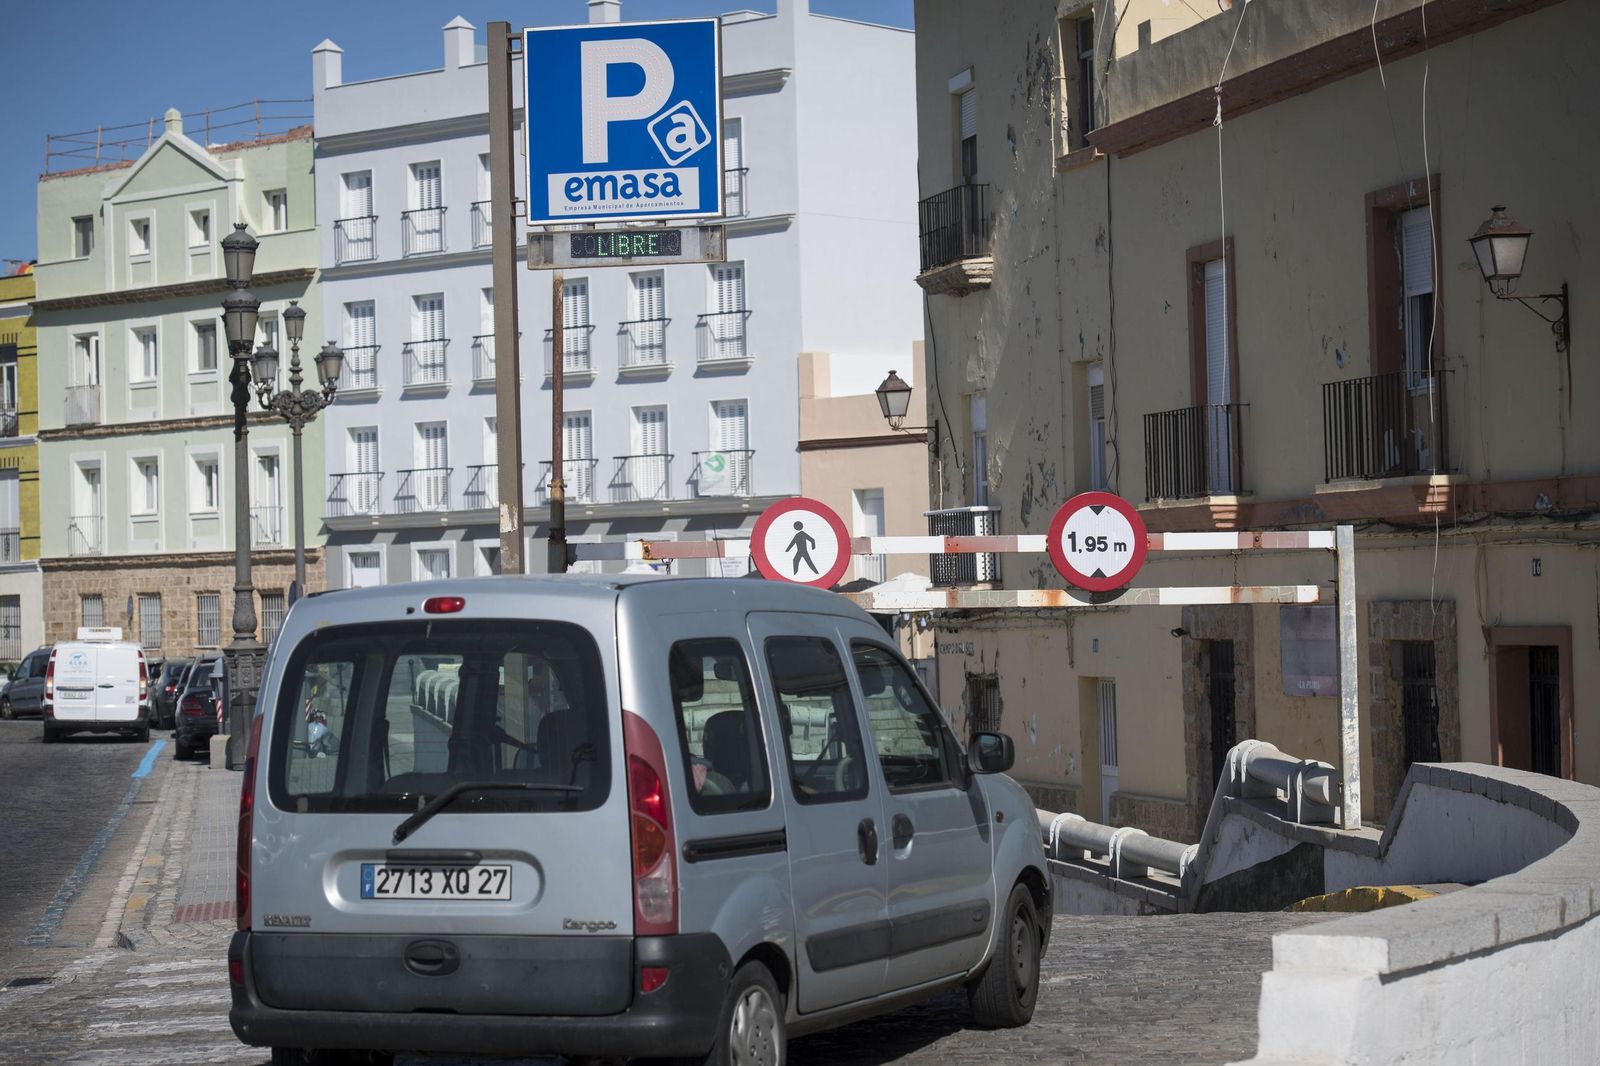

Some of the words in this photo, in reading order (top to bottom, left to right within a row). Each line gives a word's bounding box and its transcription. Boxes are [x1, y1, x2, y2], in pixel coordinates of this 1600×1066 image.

[580, 38, 675, 165] P
[564, 172, 682, 202] emasa
[598, 232, 659, 256] LIBRE
[1067, 531, 1109, 554] 1,95
[1113, 542, 1127, 552] m
[376, 868, 433, 895] 2713
[441, 868, 470, 895] XQ
[478, 868, 508, 895] 27
[562, 917, 617, 933] Kangoo
